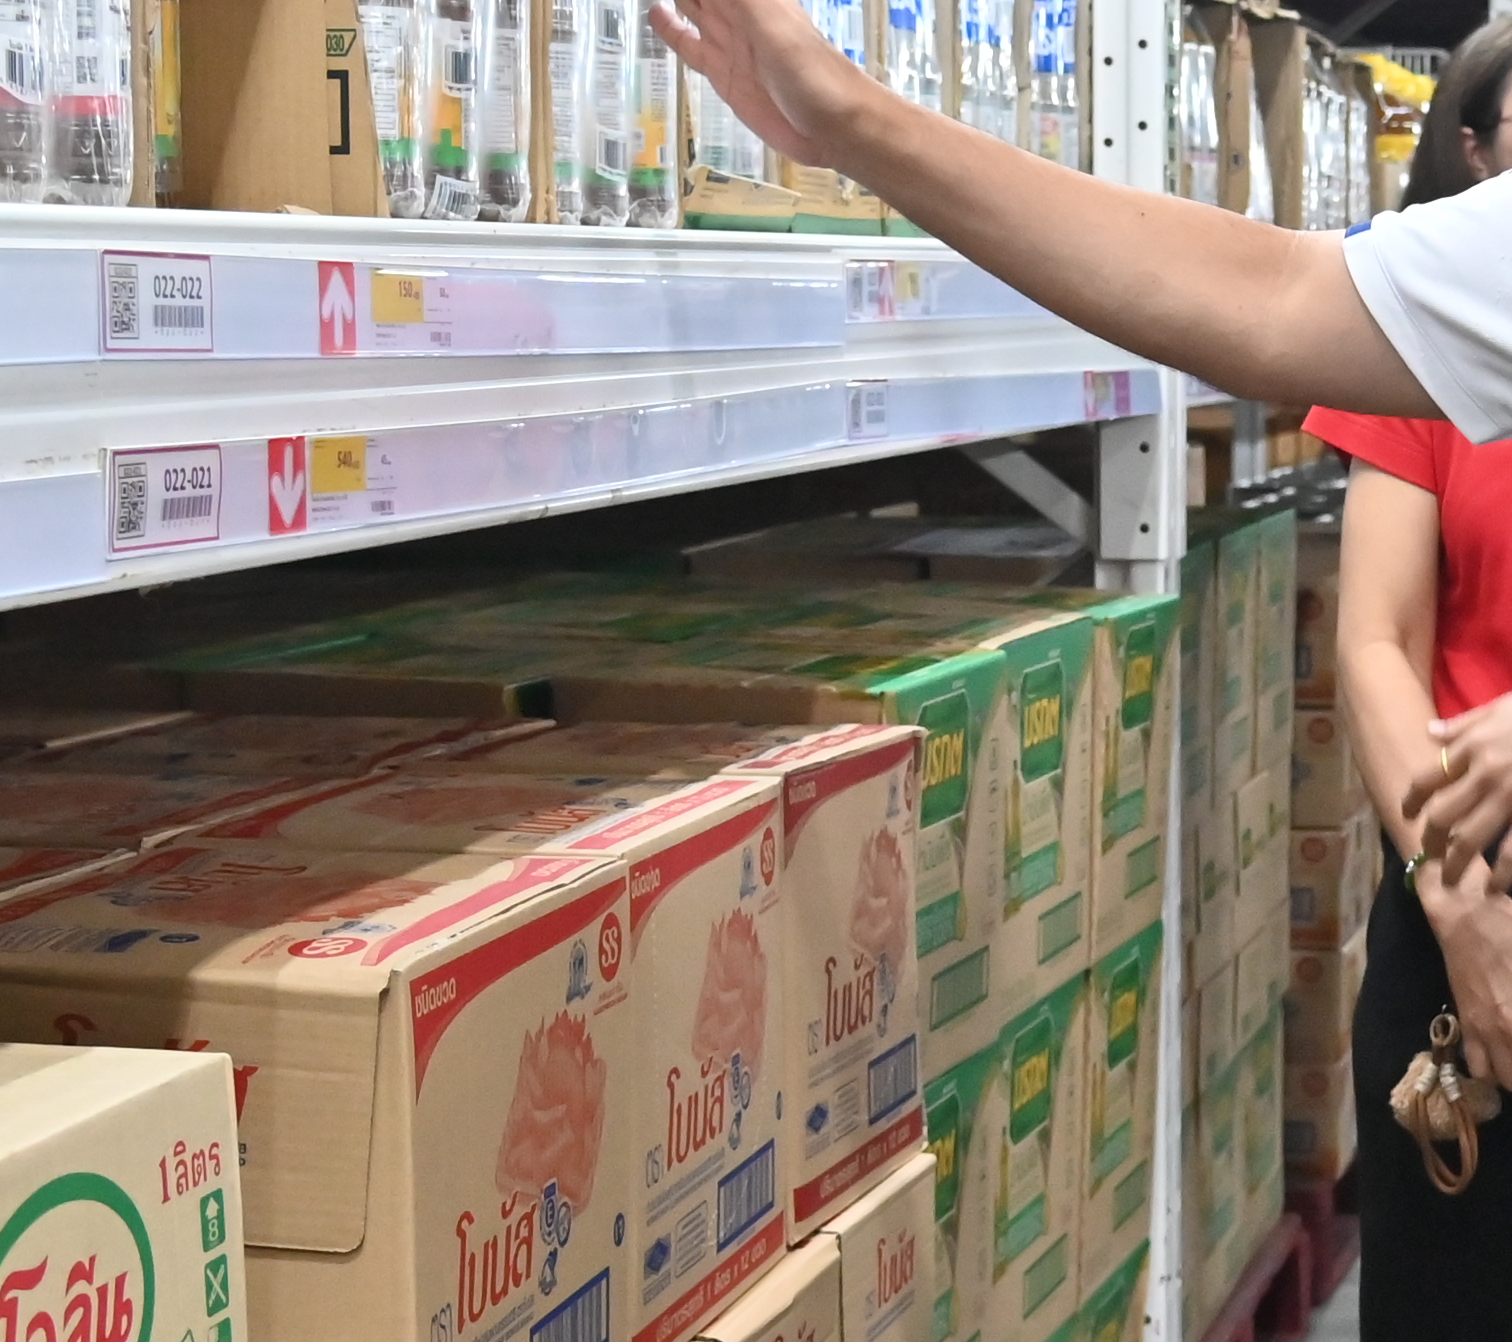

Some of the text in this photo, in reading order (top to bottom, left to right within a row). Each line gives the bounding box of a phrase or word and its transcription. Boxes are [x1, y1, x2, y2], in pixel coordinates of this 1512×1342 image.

[153, 275, 203, 300] 022-022
[164, 466, 213, 493] 022-021
[414, 976, 457, 1019] ชนิดขวด
[666, 1055, 726, 1173] โบนัส
[159, 1140, 222, 1205] 1 ลิตร
[456, 1190, 538, 1335] โบนัส
